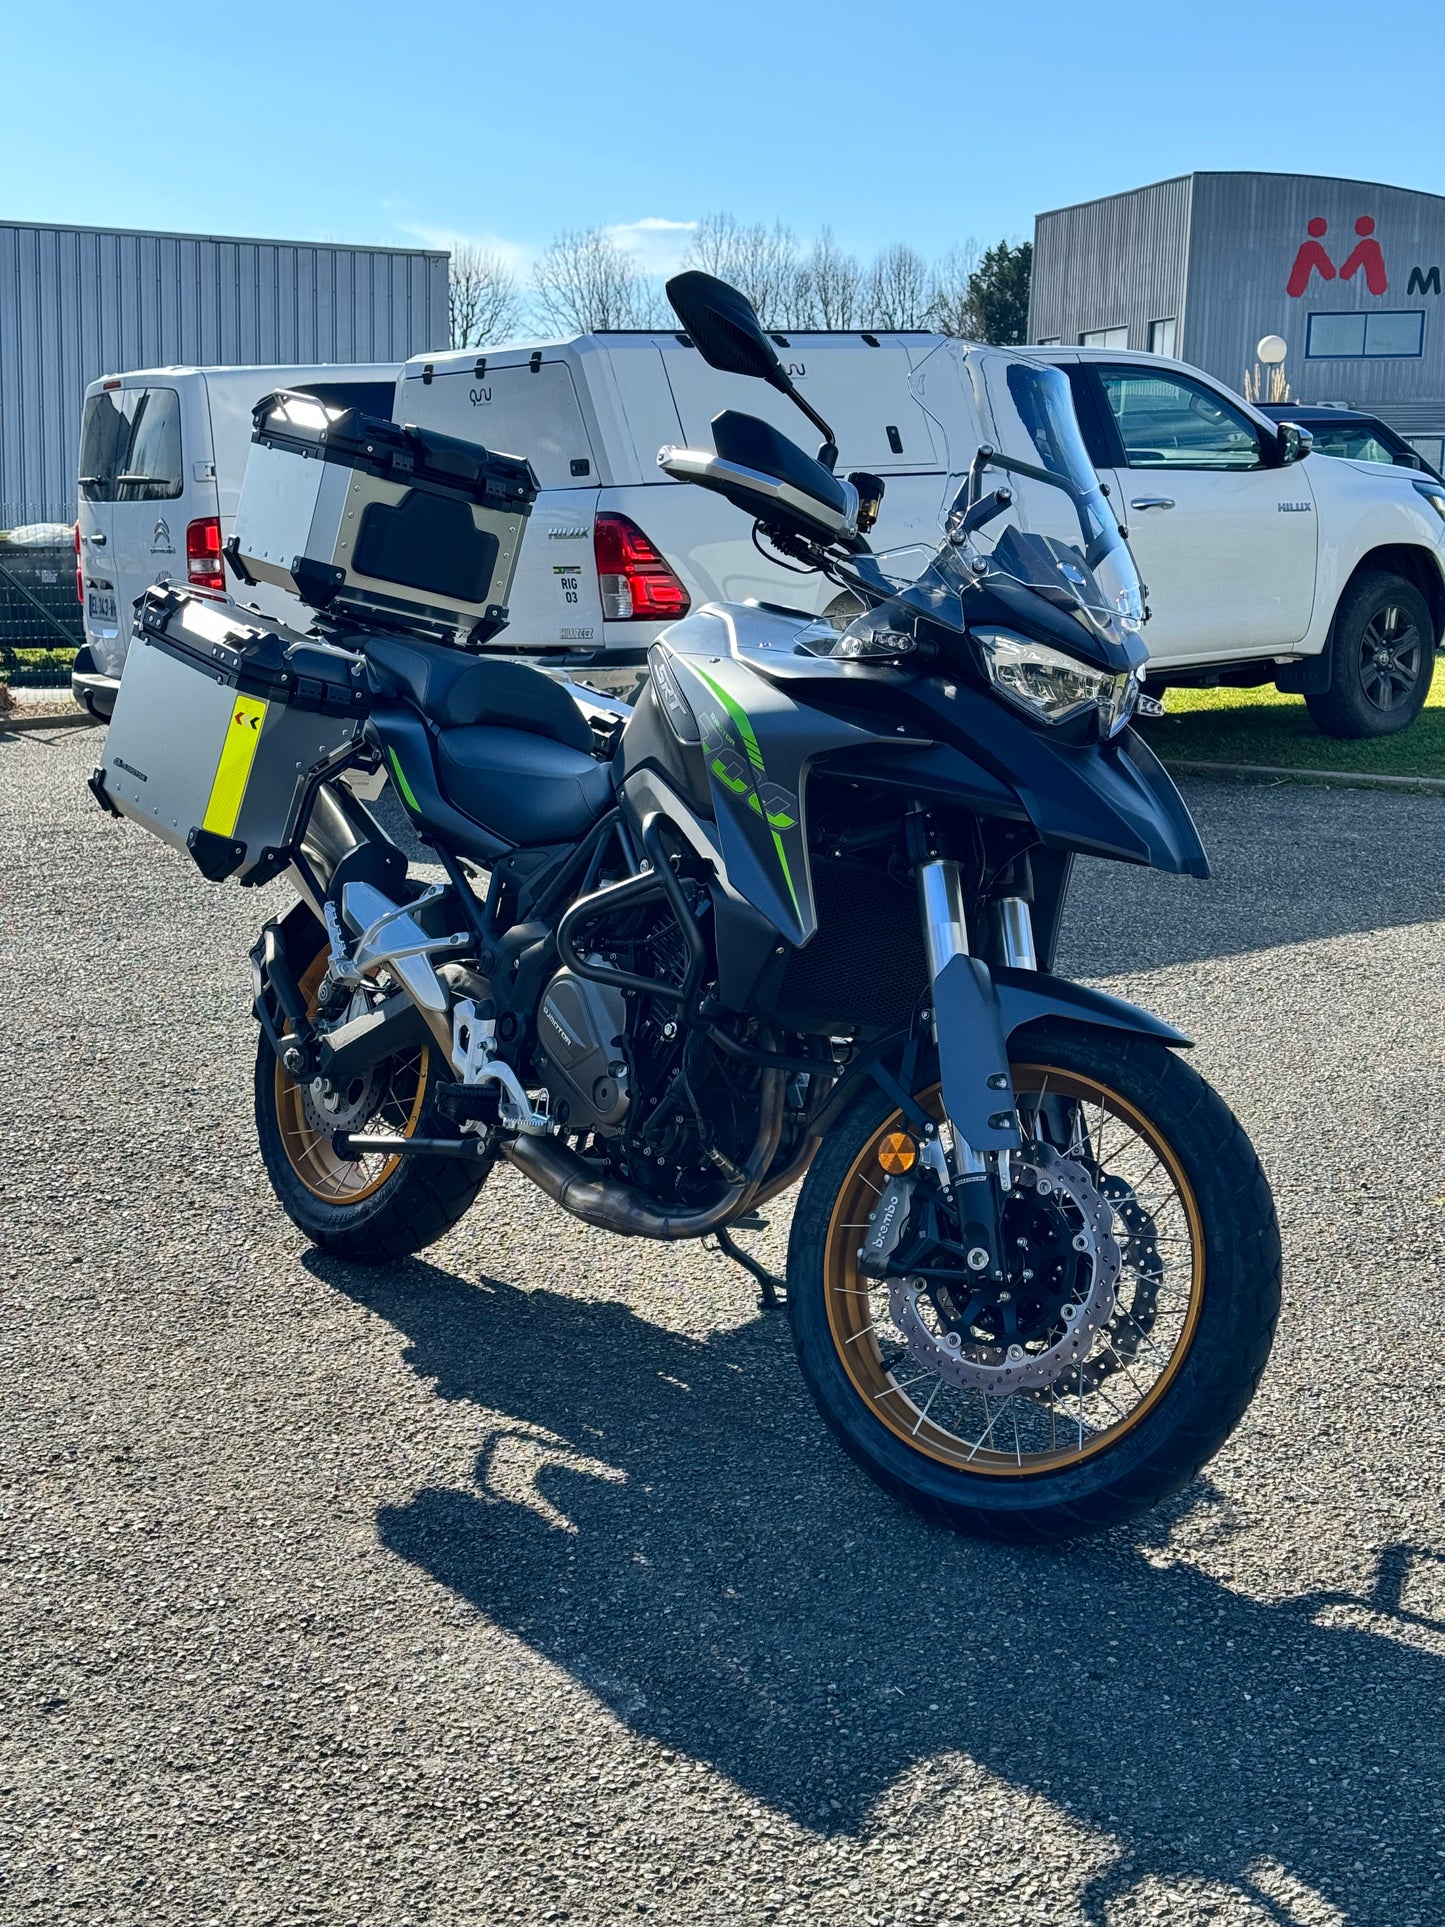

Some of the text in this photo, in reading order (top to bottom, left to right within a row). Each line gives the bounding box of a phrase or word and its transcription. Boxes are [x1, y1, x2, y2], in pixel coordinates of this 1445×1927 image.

[1277, 502, 1311, 513] HILUX
[548, 526, 590, 540] HILUX
[560, 578, 578, 590] RIG
[565, 591, 578, 604] 03
[653, 663, 687, 717] SRT
[543, 1006, 572, 1047] QJMOTOR
[872, 1196, 899, 1249] brembo
